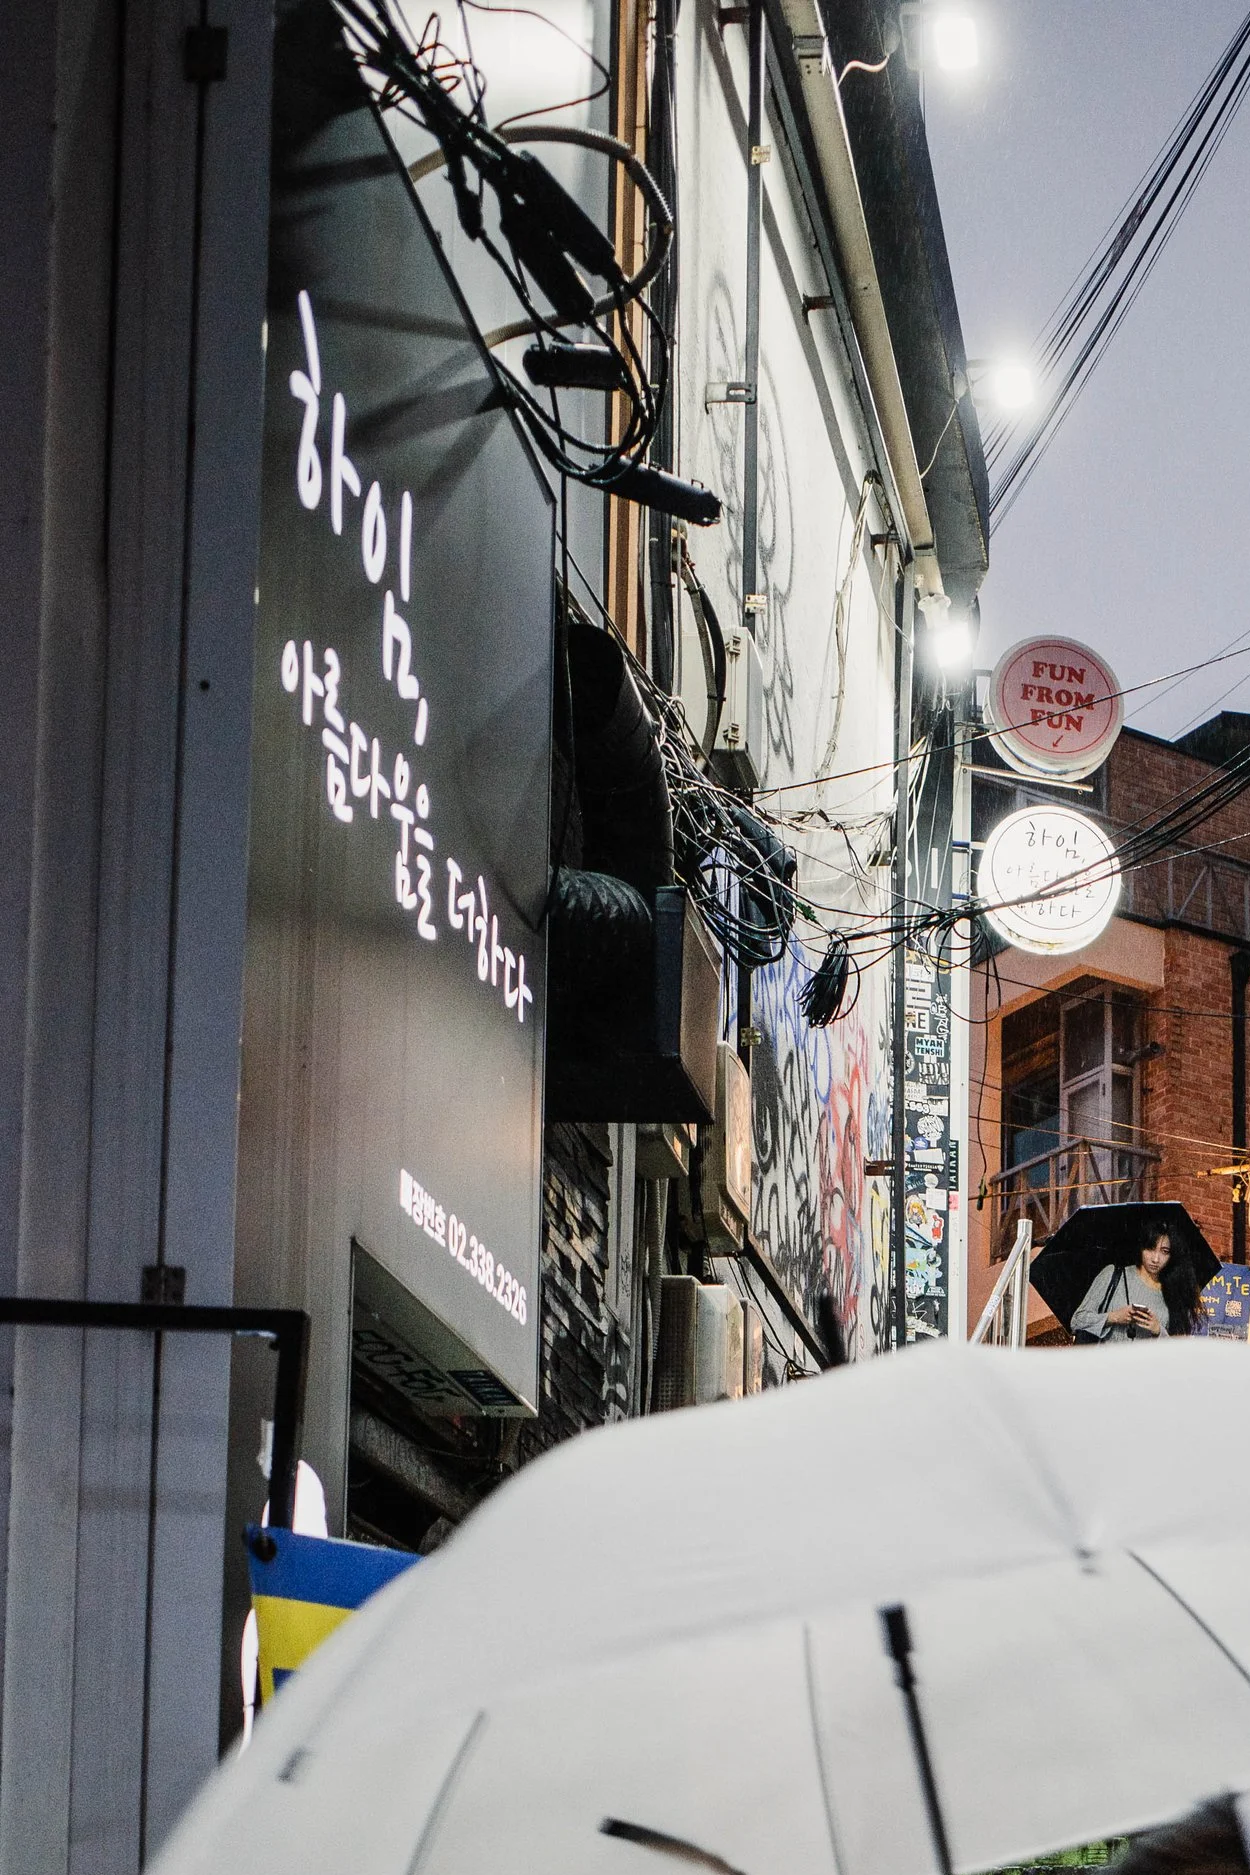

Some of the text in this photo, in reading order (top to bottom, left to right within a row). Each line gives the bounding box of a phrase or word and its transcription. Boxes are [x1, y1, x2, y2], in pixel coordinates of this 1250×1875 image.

[1032, 661, 1087, 685] FUN
[1020, 683, 1096, 711] FROM
[1030, 708, 1084, 733] FUN
[281, 640, 533, 1022] 아름다움을 더하다
[448, 1214, 527, 1326] 02.338.2326
